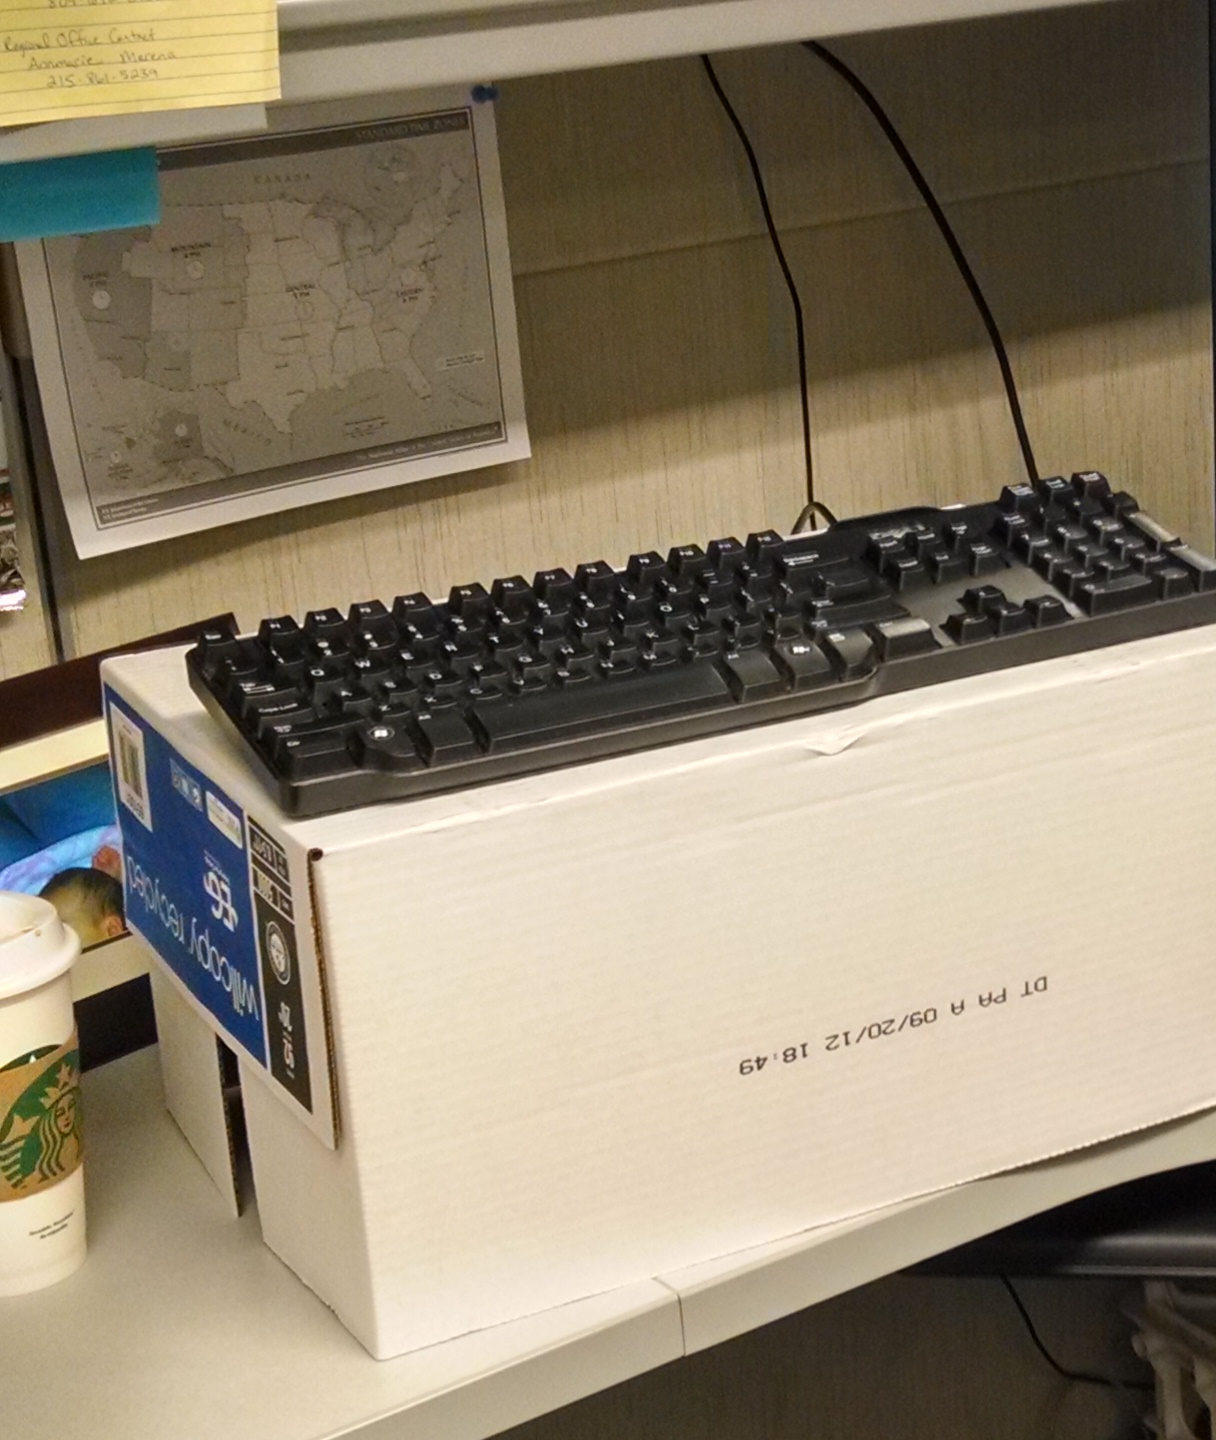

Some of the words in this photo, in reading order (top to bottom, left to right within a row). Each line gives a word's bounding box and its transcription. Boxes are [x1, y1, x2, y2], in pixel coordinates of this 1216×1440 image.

[125, 854, 186, 948] recycled
[188, 917, 260, 1022] willcopy
[978, 988, 1007, 1008] PA
[1020, 976, 1049, 998] DT
[950, 999, 965, 1016] A
[825, 1007, 938, 1052] 09/20/12
[739, 1042, 809, 1076] 18:49
